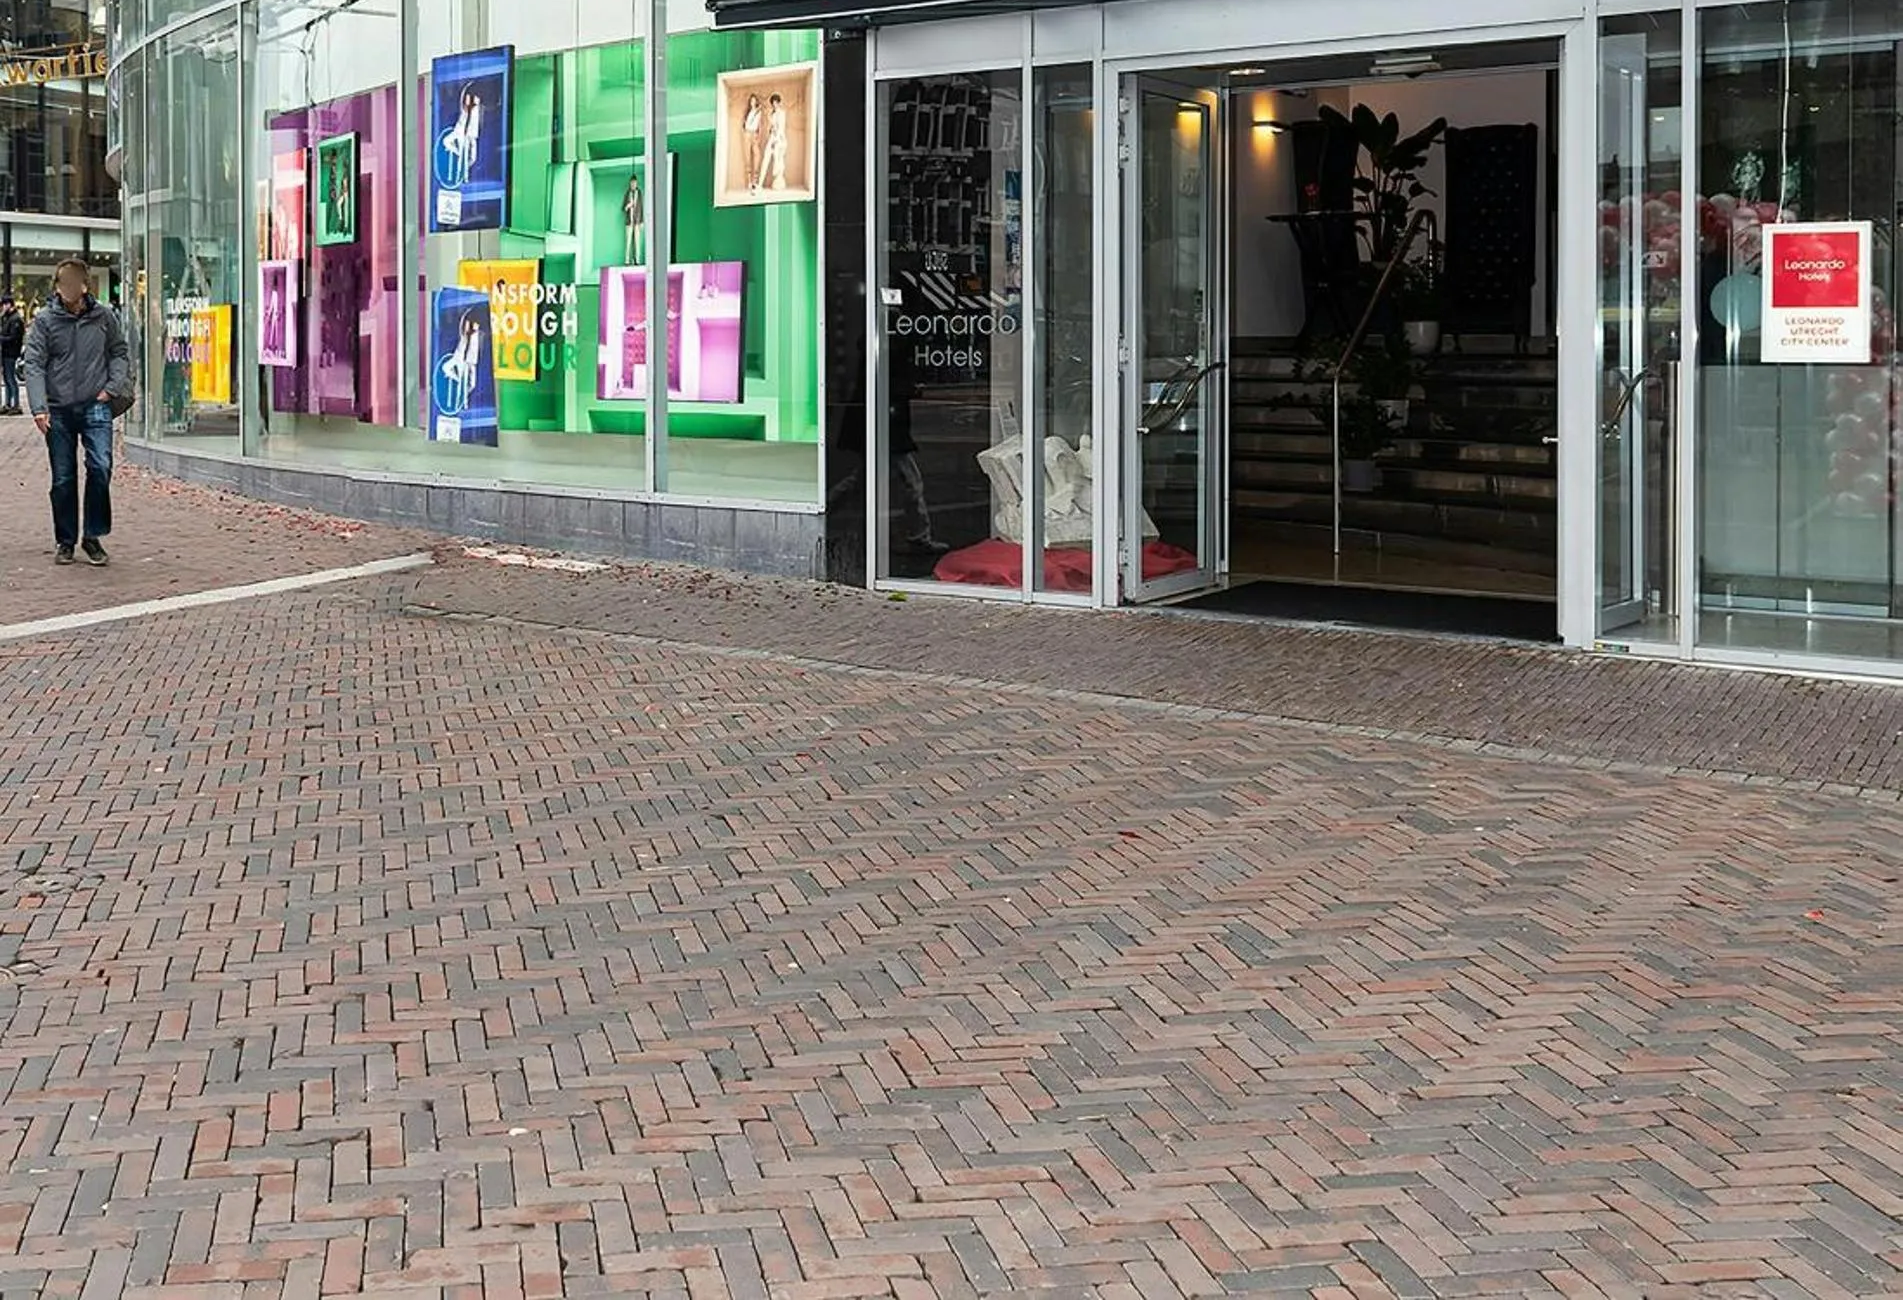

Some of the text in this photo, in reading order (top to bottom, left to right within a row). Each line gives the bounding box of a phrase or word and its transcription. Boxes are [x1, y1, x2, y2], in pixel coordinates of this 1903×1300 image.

[1784, 258, 1846, 271] Leonardo
[885, 308, 1017, 335] Leonardo
[1784, 316, 1846, 326] LEONARDO
[1789, 327, 1840, 336] UTRECHT
[1780, 337, 1804, 347] CITY
[914, 345, 983, 367] Hotels
